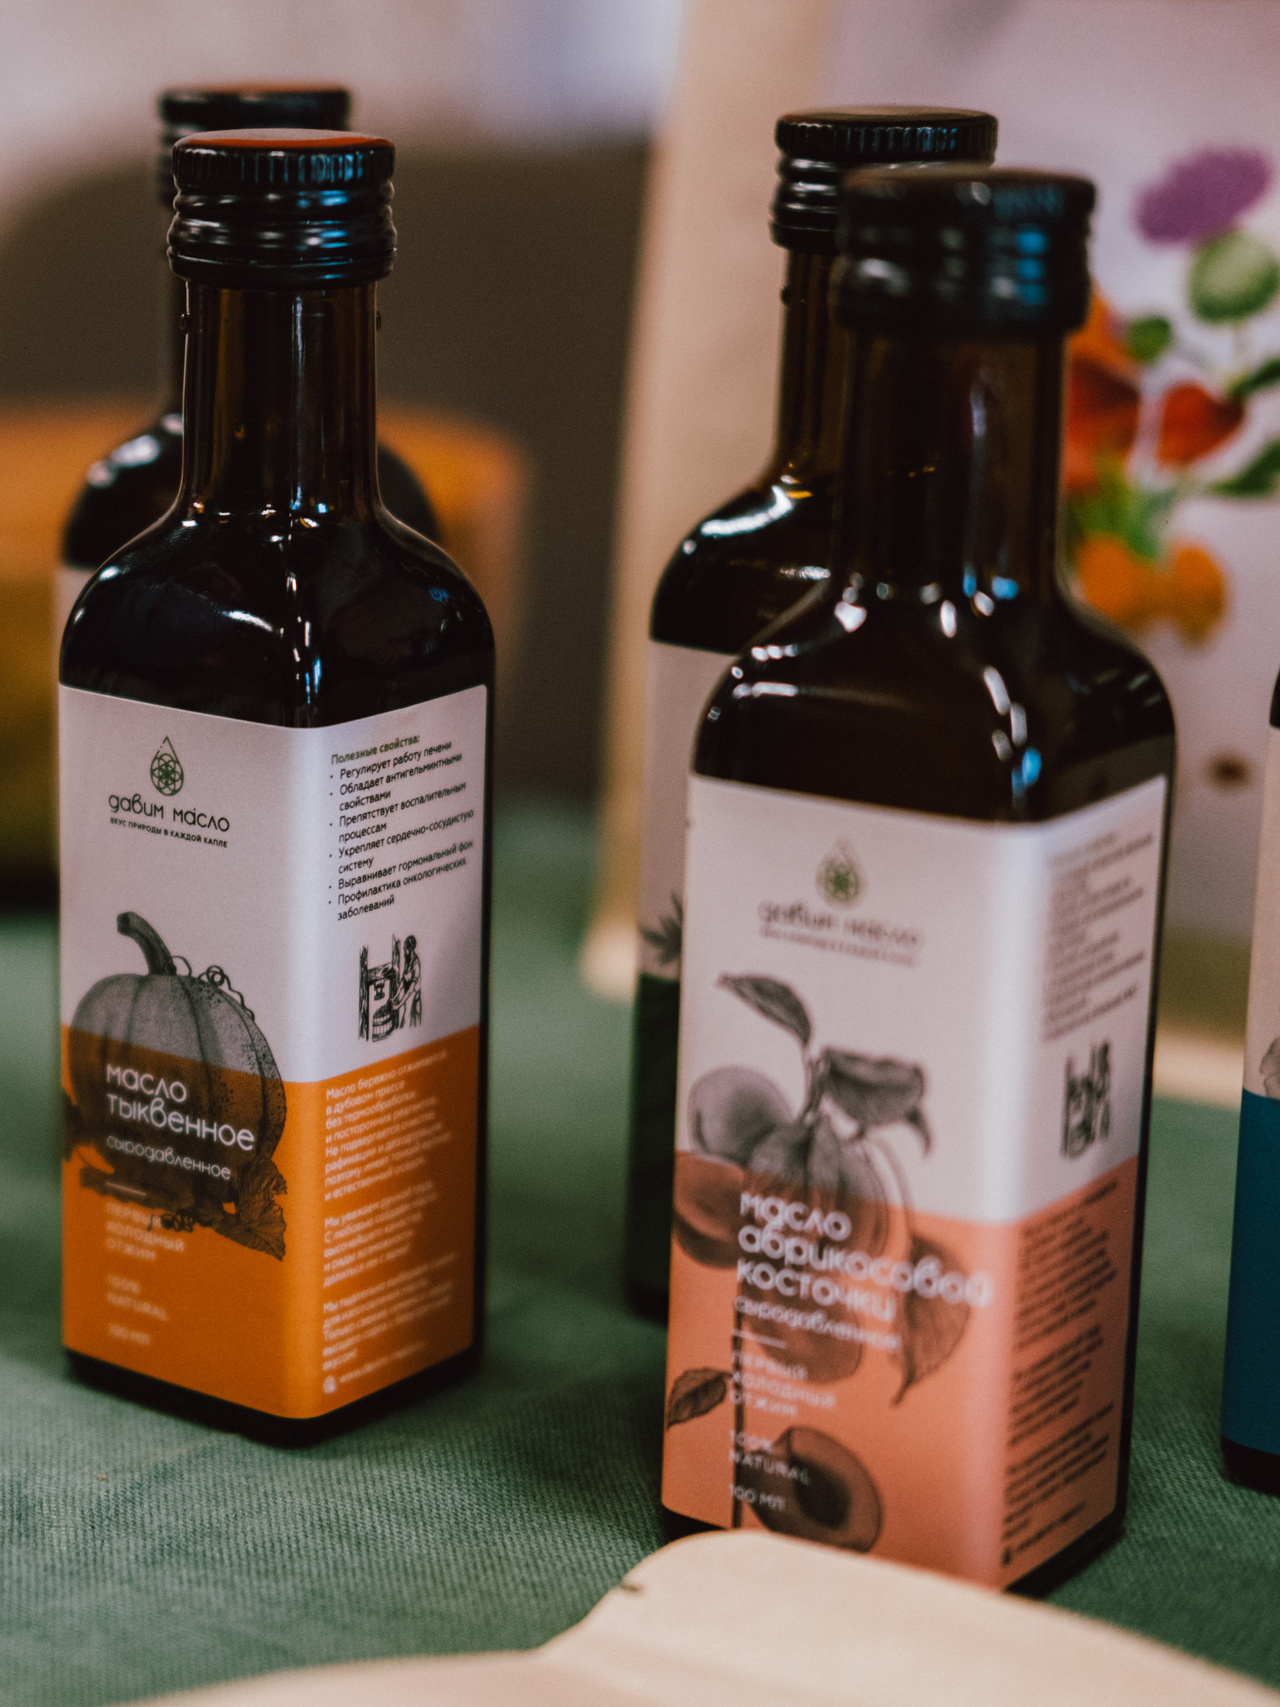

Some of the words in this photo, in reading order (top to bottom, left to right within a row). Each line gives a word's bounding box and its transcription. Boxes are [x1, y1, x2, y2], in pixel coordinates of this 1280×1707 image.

[331, 746, 377, 765] Полезные
[379, 735, 420, 753] свойства:
[340, 759, 391, 779] Регулирует
[393, 750, 422, 766] работу
[423, 741, 452, 756] печени
[339, 776, 384, 796] Обладает
[386, 753, 463, 784] антигельминтными
[108, 793, 164, 819] давим
[173, 807, 230, 832] масло
[339, 790, 391, 812] свойствами
[339, 803, 398, 827] Препятствует
[401, 782, 467, 810] воспалительным
[110, 817, 127, 827] ВКУС
[128, 821, 162, 835] ПРИРОДЫ
[170, 830, 202, 843] КАЖДОЙ
[204, 837, 228, 849] КАПЛЕ
[339, 822, 387, 843] процессам
[339, 839, 385, 859] Укрепляет
[386, 809, 474, 845] сердечно-сосудистую
[338, 866, 397, 890] Выравнивает
[398, 843, 457, 872] гормональный
[458, 839, 474, 854] фон
[338, 857, 374, 874] систему
[338, 879, 401, 905] Профилактика
[403, 857, 467, 886] онкологических
[337, 895, 395, 921] заболеваний
[106, 1063, 187, 1103] масло
[326, 1083, 356, 1100] Масло
[357, 1069, 397, 1091] бережно
[333, 1092, 374, 1114] дубовом
[375, 1080, 405, 1098] прессе
[107, 1093, 255, 1151] тыквенное
[325, 1115, 342, 1130] без
[106, 1135, 231, 1180] сыродавленное
[325, 1146, 338, 1158] Не
[740, 1192, 852, 1242] масло
[738, 1223, 994, 1308] абрикосовой
[736, 1258, 897, 1322] косточки
[728, 1449, 810, 1486] NATURAL
